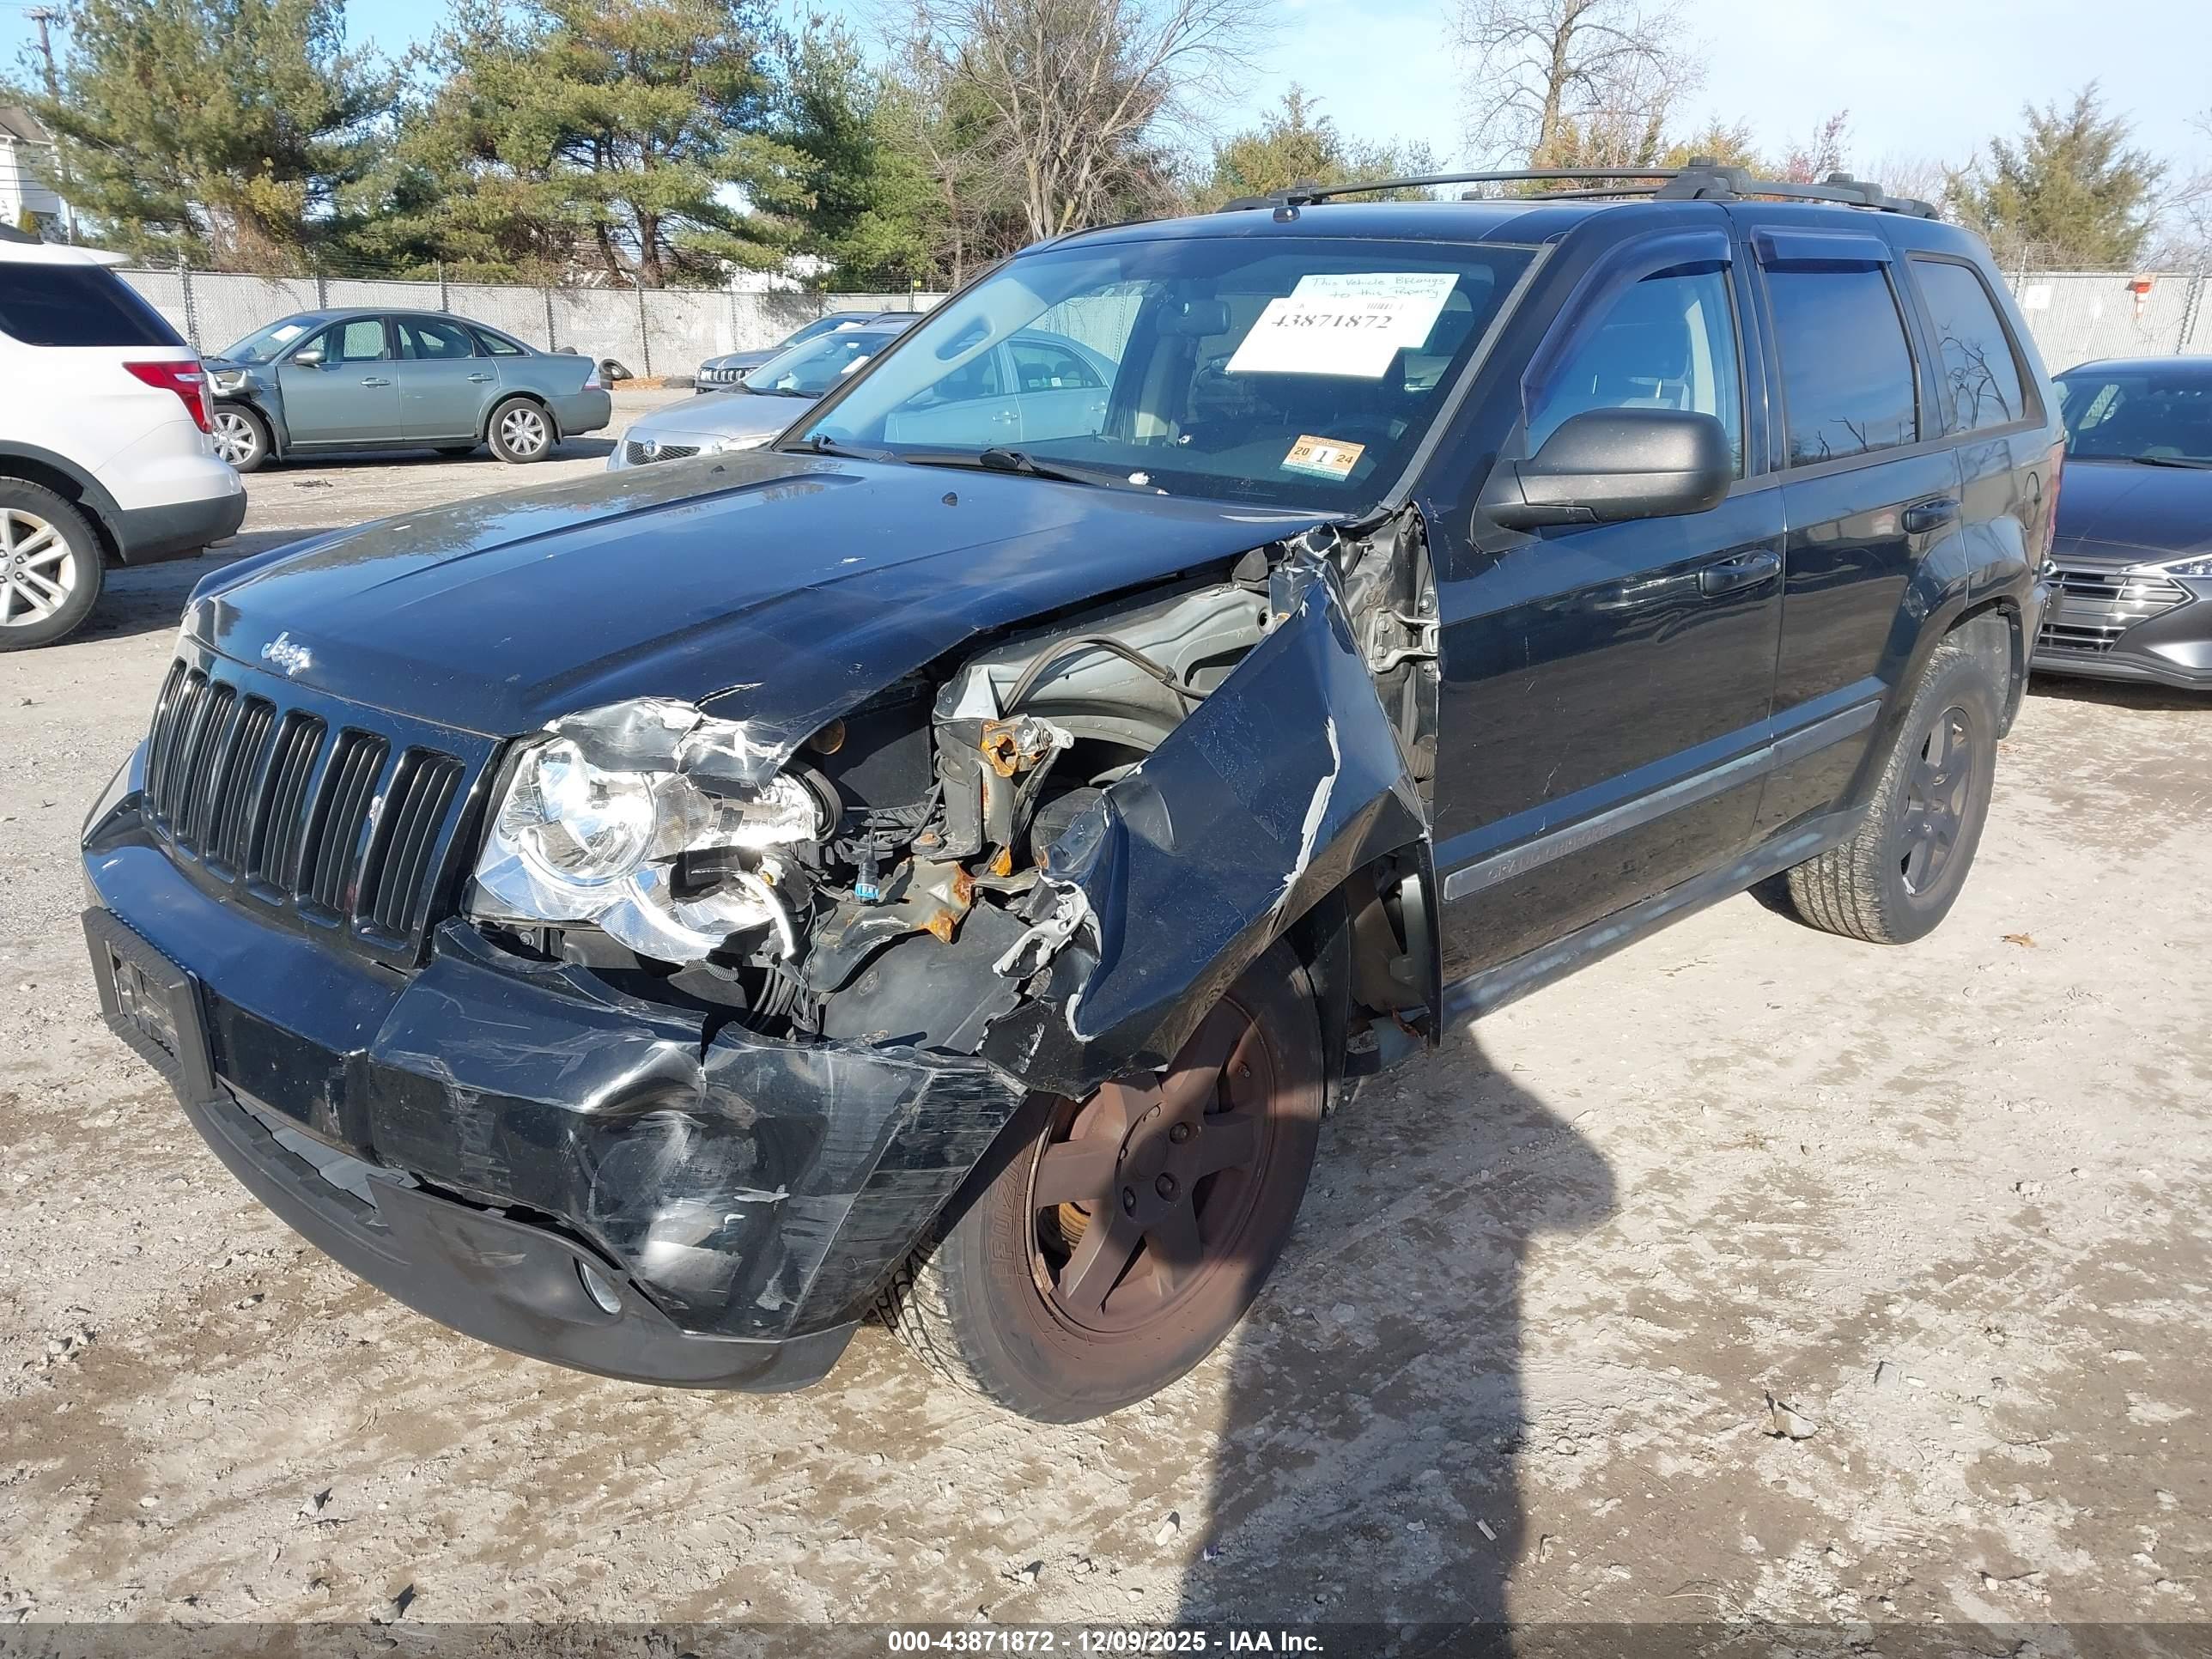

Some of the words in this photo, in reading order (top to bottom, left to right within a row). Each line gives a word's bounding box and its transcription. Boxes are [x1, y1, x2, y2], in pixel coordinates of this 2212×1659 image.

[1311, 276, 1339, 288] This
[1346, 277, 1386, 287] Vehicle
[1358, 288, 1382, 297] this
[1271, 313, 1393, 330] 43871872
[1294, 447, 1311, 456] 20
[1316, 450, 1328, 463] 1
[1336, 454, 1354, 464] 24
[260, 631, 313, 676] Jeep
